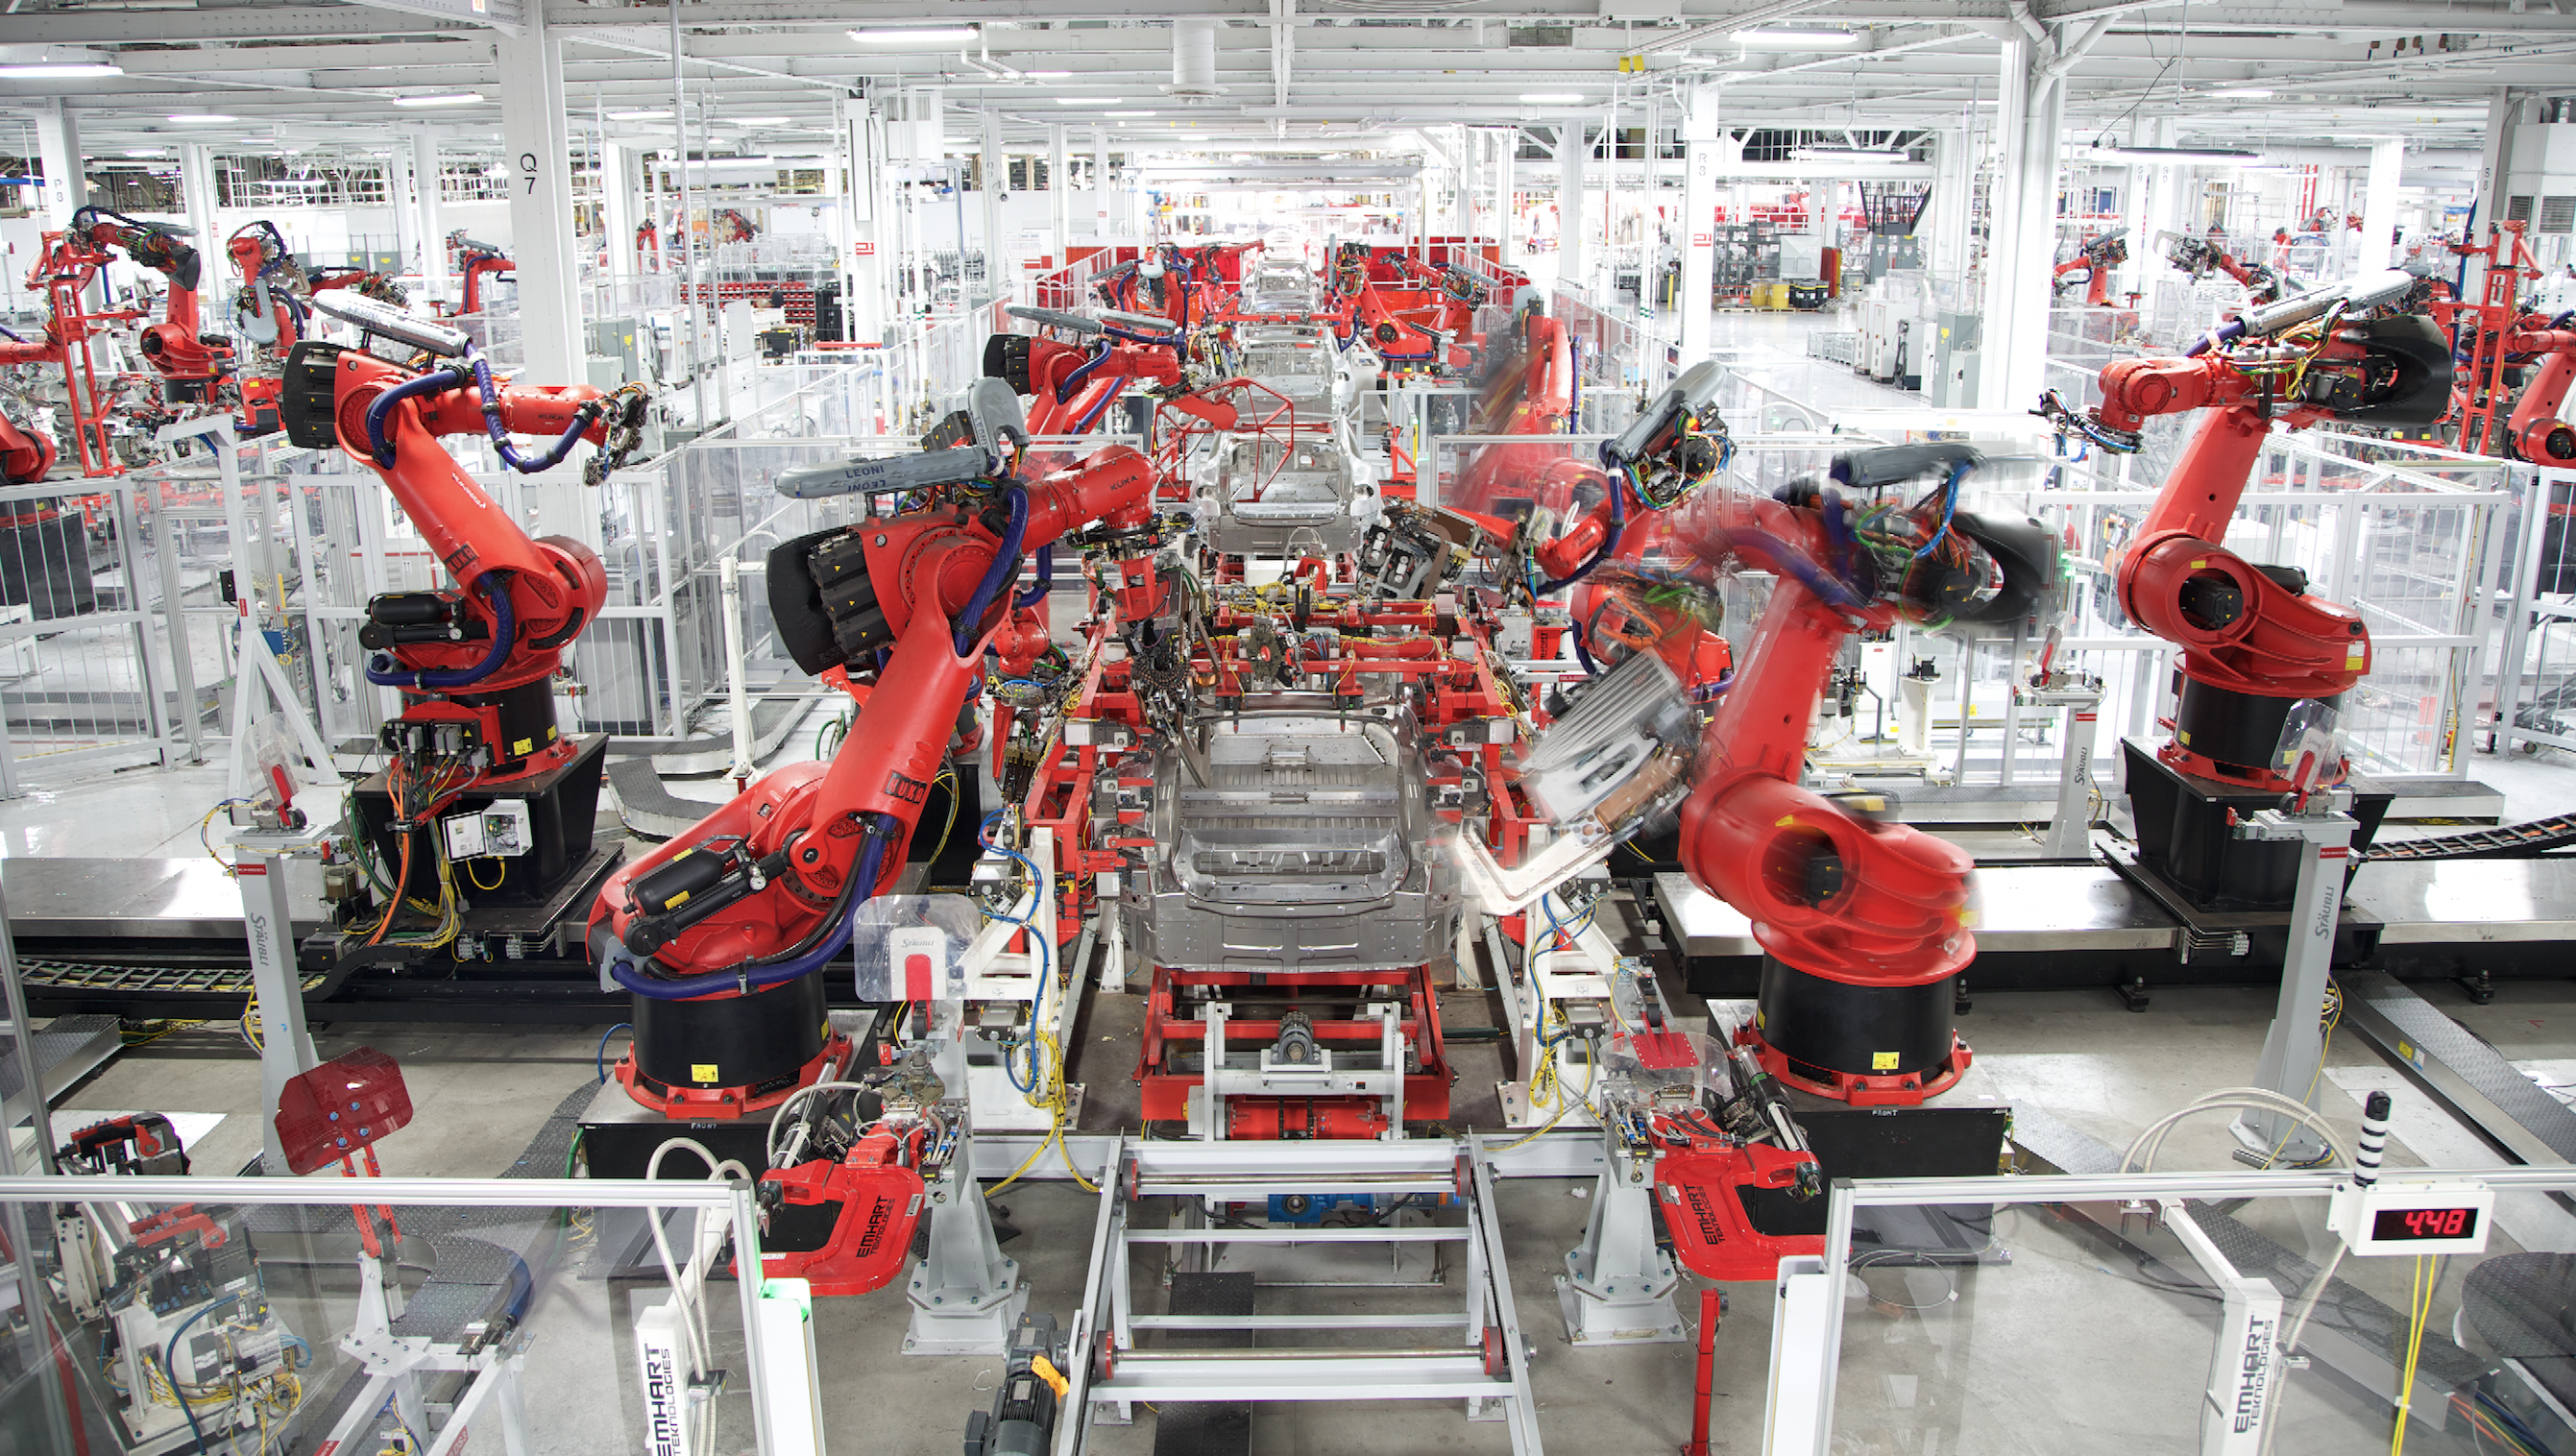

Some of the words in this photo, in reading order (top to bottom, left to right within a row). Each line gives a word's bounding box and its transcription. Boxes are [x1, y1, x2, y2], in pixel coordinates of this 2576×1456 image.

[520, 154, 538, 173] Q
[1698, 153, 1708, 163] R
[1998, 153, 2005, 170] R
[1698, 165, 1707, 177] 8
[2484, 167, 2491, 178] S
[54, 179, 62, 189] P
[524, 177, 536, 195] 7
[1998, 175, 2005, 193] 7
[2482, 180, 2489, 191] 8
[56, 192, 64, 203] 8
[2330, 351, 2360, 360] KUKA
[975, 416, 988, 448] LEONI
[845, 465, 885, 479] LEONI
[847, 480, 887, 493] LEONI
[1110, 474, 1138, 491] KUKA
[446, 546, 475, 573] KUKA
[2075, 746, 2088, 787] STÄUBLI
[887, 776, 925, 803] KUKA
[2315, 885, 2334, 940] STÄUBLI
[251, 911, 269, 967] STÄUBLI
[901, 938, 935, 948] STÄUBLI
[691, 1122, 717, 1130] FRONT
[1683, 1183, 1719, 1246] EMHART
[1696, 1185, 1726, 1244] TEKNOLOGIES
[856, 1195, 888, 1258] EMHART
[869, 1199, 896, 1256] TEKNOLOGIES
[2233, 1314, 2265, 1434] EMHART
[2248, 1320, 2273, 1430] TEKNOLOGIES
